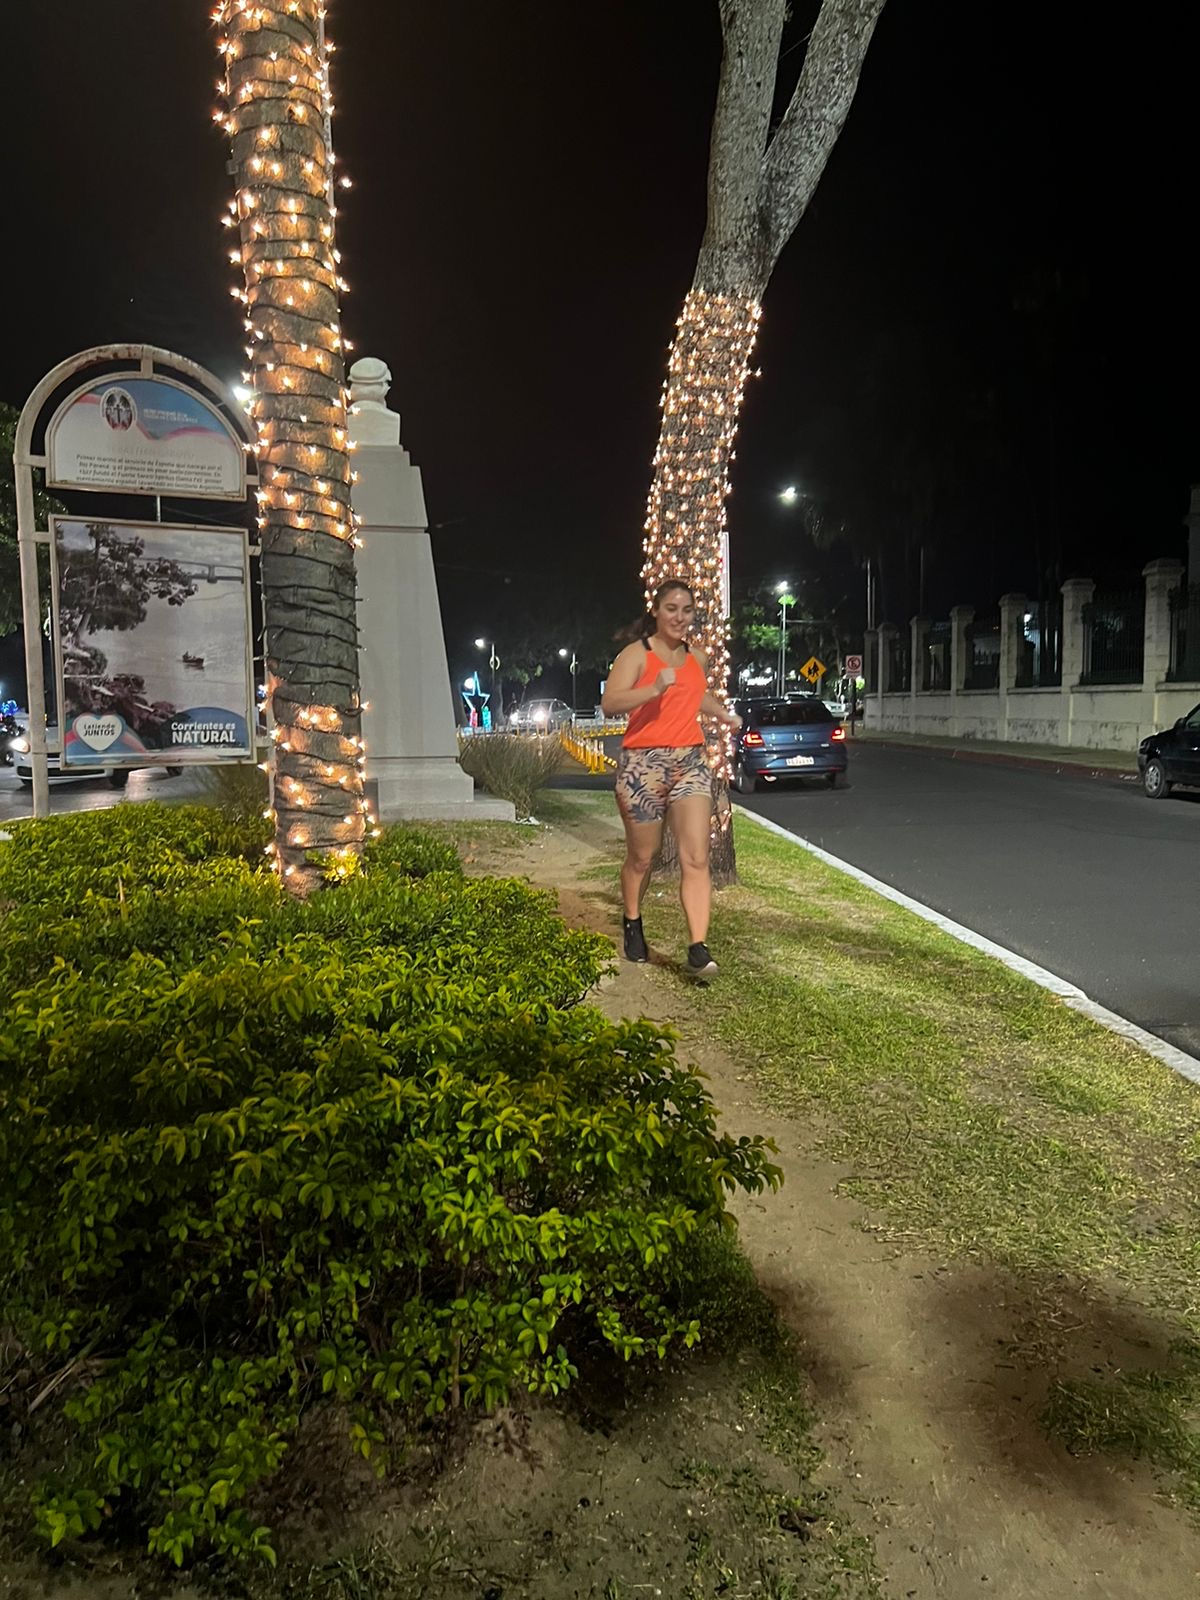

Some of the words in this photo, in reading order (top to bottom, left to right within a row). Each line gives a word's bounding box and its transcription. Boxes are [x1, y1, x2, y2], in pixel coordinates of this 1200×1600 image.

[171, 721, 224, 731] Corrientes
[225, 723, 236, 731] es
[83, 729, 115, 737] JUNTOS
[172, 731, 236, 744] NATURAL
